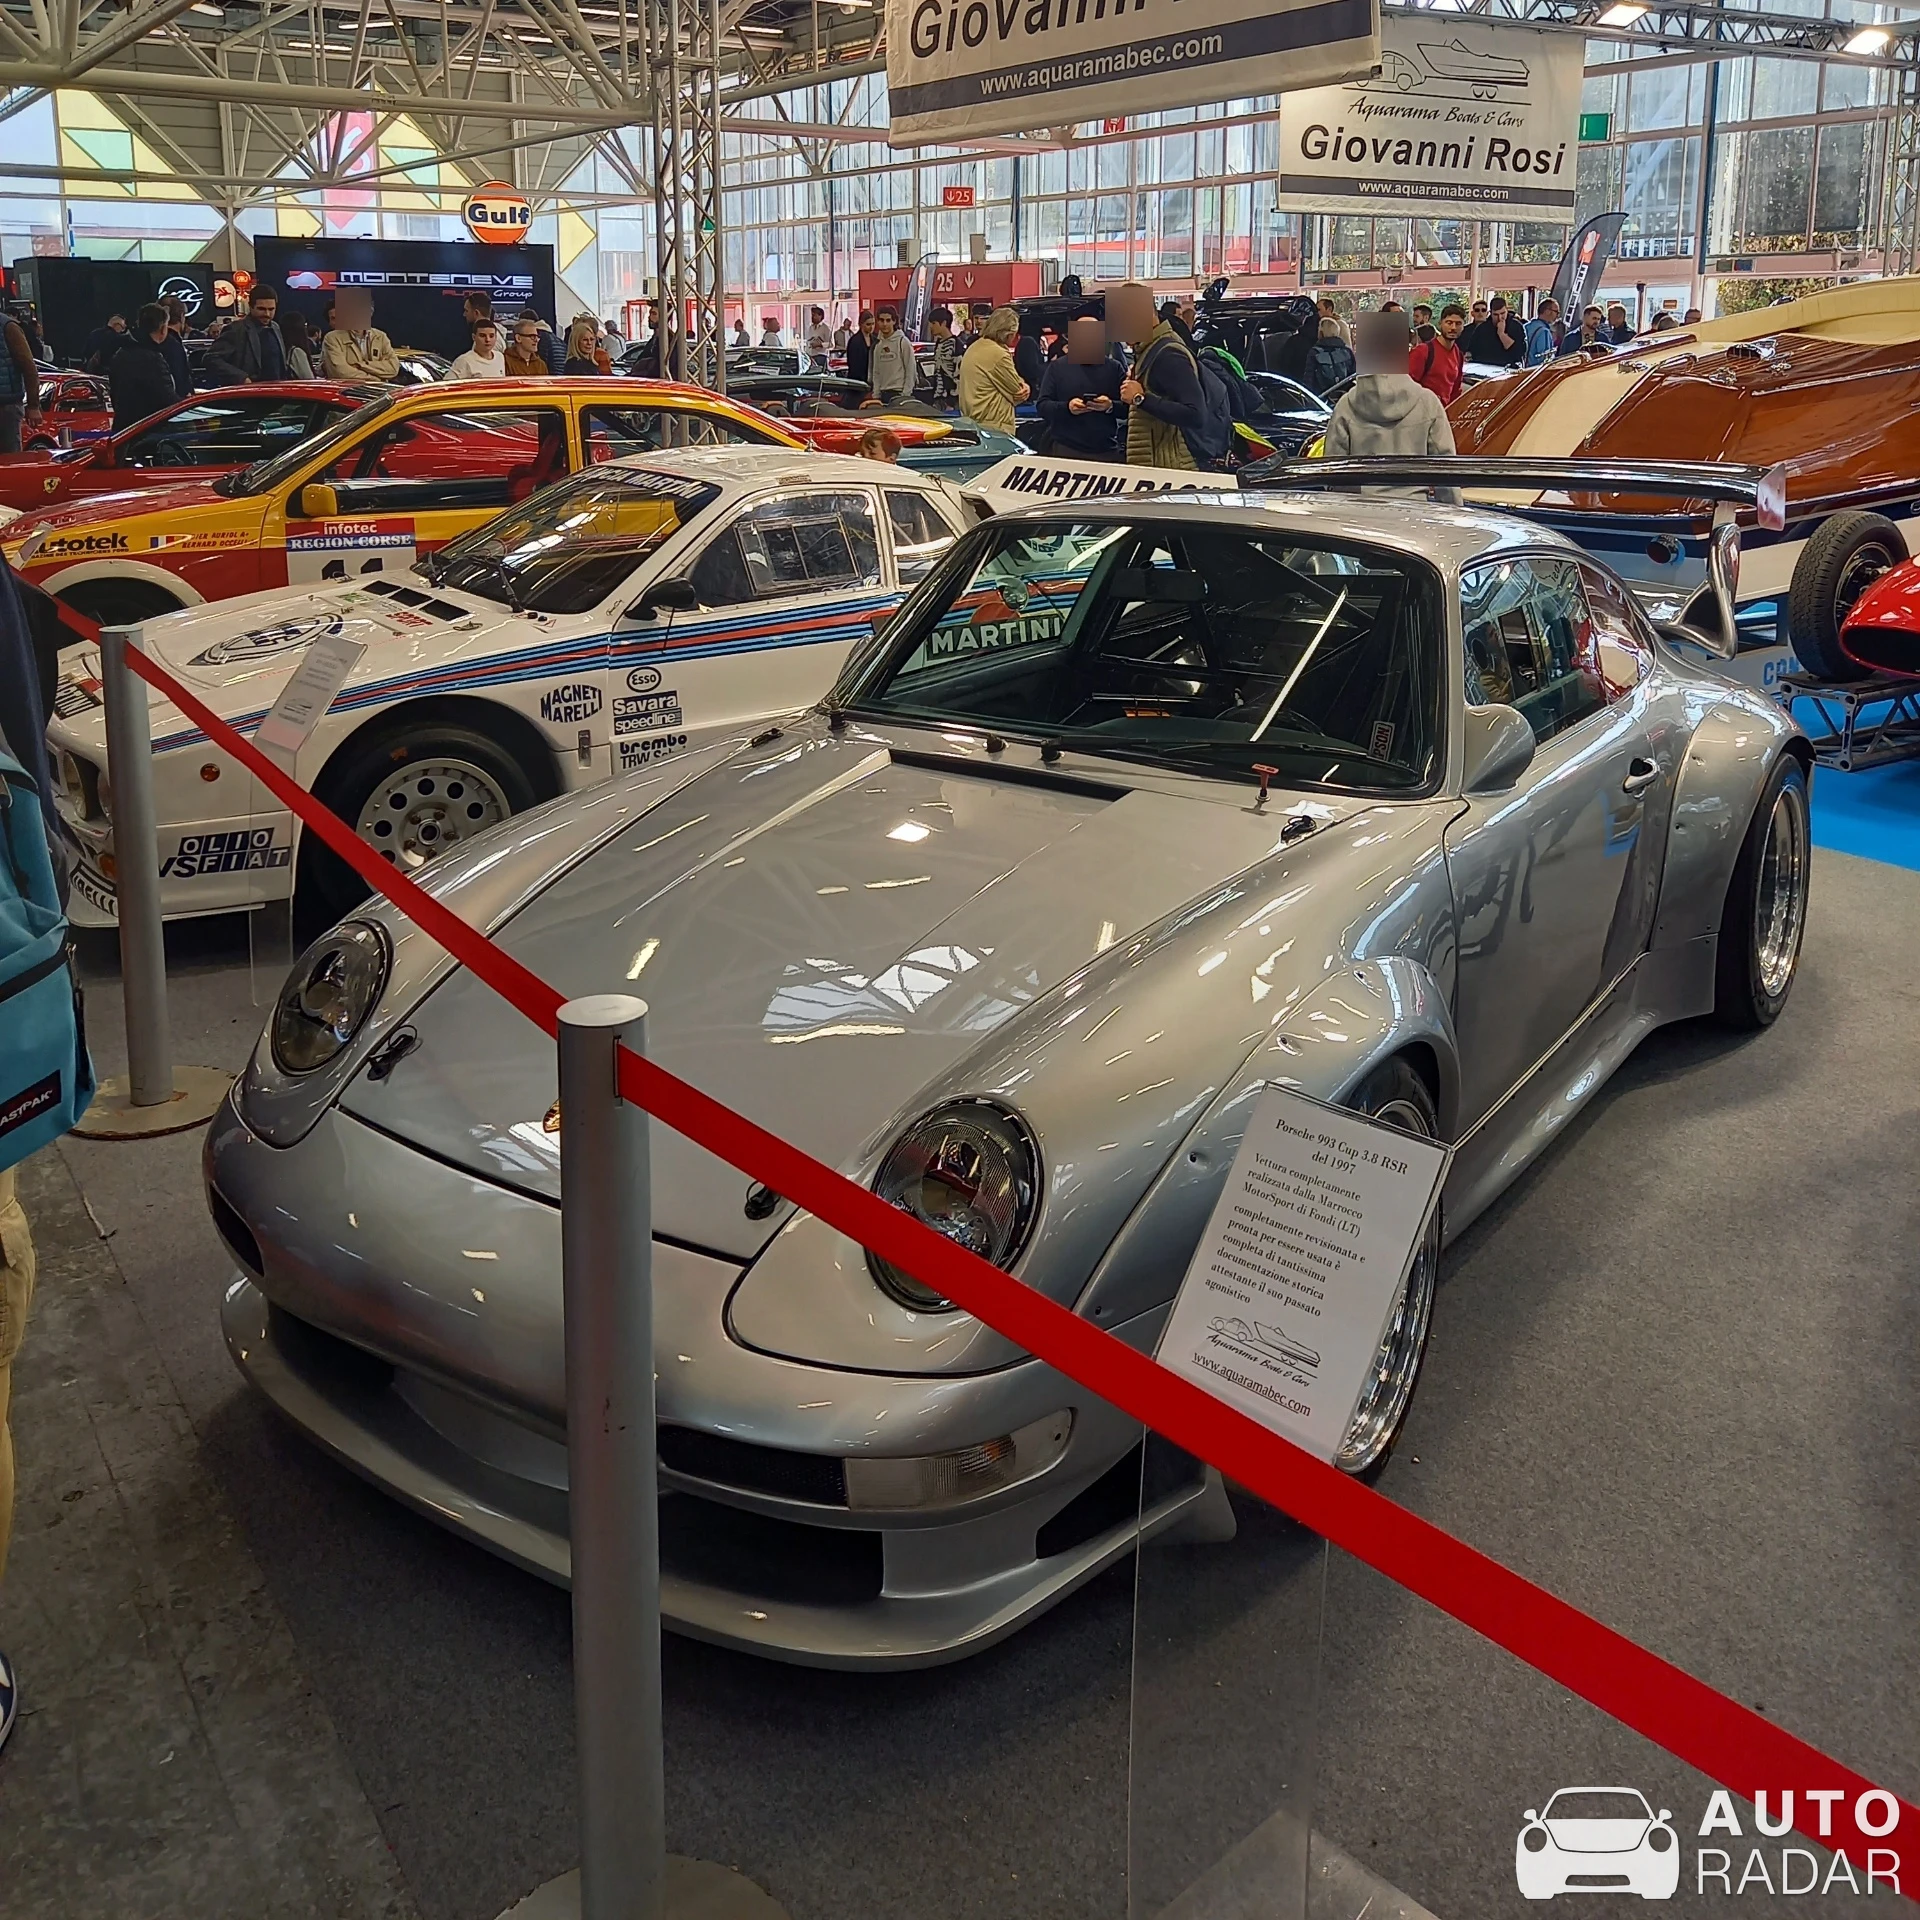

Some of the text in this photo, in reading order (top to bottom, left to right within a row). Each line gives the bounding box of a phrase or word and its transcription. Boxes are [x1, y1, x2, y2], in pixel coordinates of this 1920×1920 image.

[909, 0, 1145, 59] Giovan
[980, 31, 1224, 95] www.aquaramabec.com
[1347, 96, 1441, 122] Aquarama
[1443, 107, 1483, 125] Boats
[1497, 113, 1526, 128] Cars
[1301, 124, 1567, 175] Giovanni Rosi
[956, 190, 970, 202] 25
[1359, 180, 1510, 200] www.aquaramabec.com
[468, 203, 530, 224] Gulf
[340, 271, 534, 286] MONTENEVE
[936, 272, 954, 293] 25
[493, 289, 533, 300] Group
[624, 472, 710, 499] MARTINI
[1001, 465, 1128, 499] MARTINI
[324, 522, 378, 535] infotec
[34, 532, 129, 554] utotek
[290, 535, 412, 550] REGION CORSE
[932, 617, 1062, 655] MARTINI
[540, 684, 603, 708] MAGNETI
[613, 693, 677, 715] Savara
[540, 699, 603, 723] MARELLI
[614, 711, 677, 733] speedline
[619, 734, 688, 755] brembo
[620, 752, 651, 770] TRW
[182, 831, 270, 854] OLIO
[202, 849, 290, 872] FIAT
[0, 1090, 53, 1127] ASTPAK
[1275, 1118, 1409, 1175] Porsche 993 Cup 3.8 RSR
[1311, 1151, 1357, 1175] del 1997
[1255, 1153, 1361, 1202] Vettura completamente
[1247, 1169, 1363, 1220] realizzata dalla Marrocco
[1242, 1181, 1361, 1239] MotorSport di Fondi (LT)
[1227, 1219, 1259, 1237] pronta
[1259, 1231, 1277, 1244] per
[1277, 1240, 1305, 1256] essere
[1306, 1252, 1333, 1268] usata
[1234, 1204, 1366, 1264] completamente revisionata e
[1222, 1234, 1326, 1283] completa di tantissima
[1216, 1247, 1325, 1301] documentazione storica
[1205, 1278, 1251, 1305] agonistico
[1210, 1262, 1322, 1317] attestante il suo passato
[1206, 1333, 1259, 1362] Aquarama
[1259, 1359, 1283, 1375] Boats
[1291, 1374, 1311, 1388] Cars
[1193, 1352, 1312, 1417] www.aquaramabec.com
